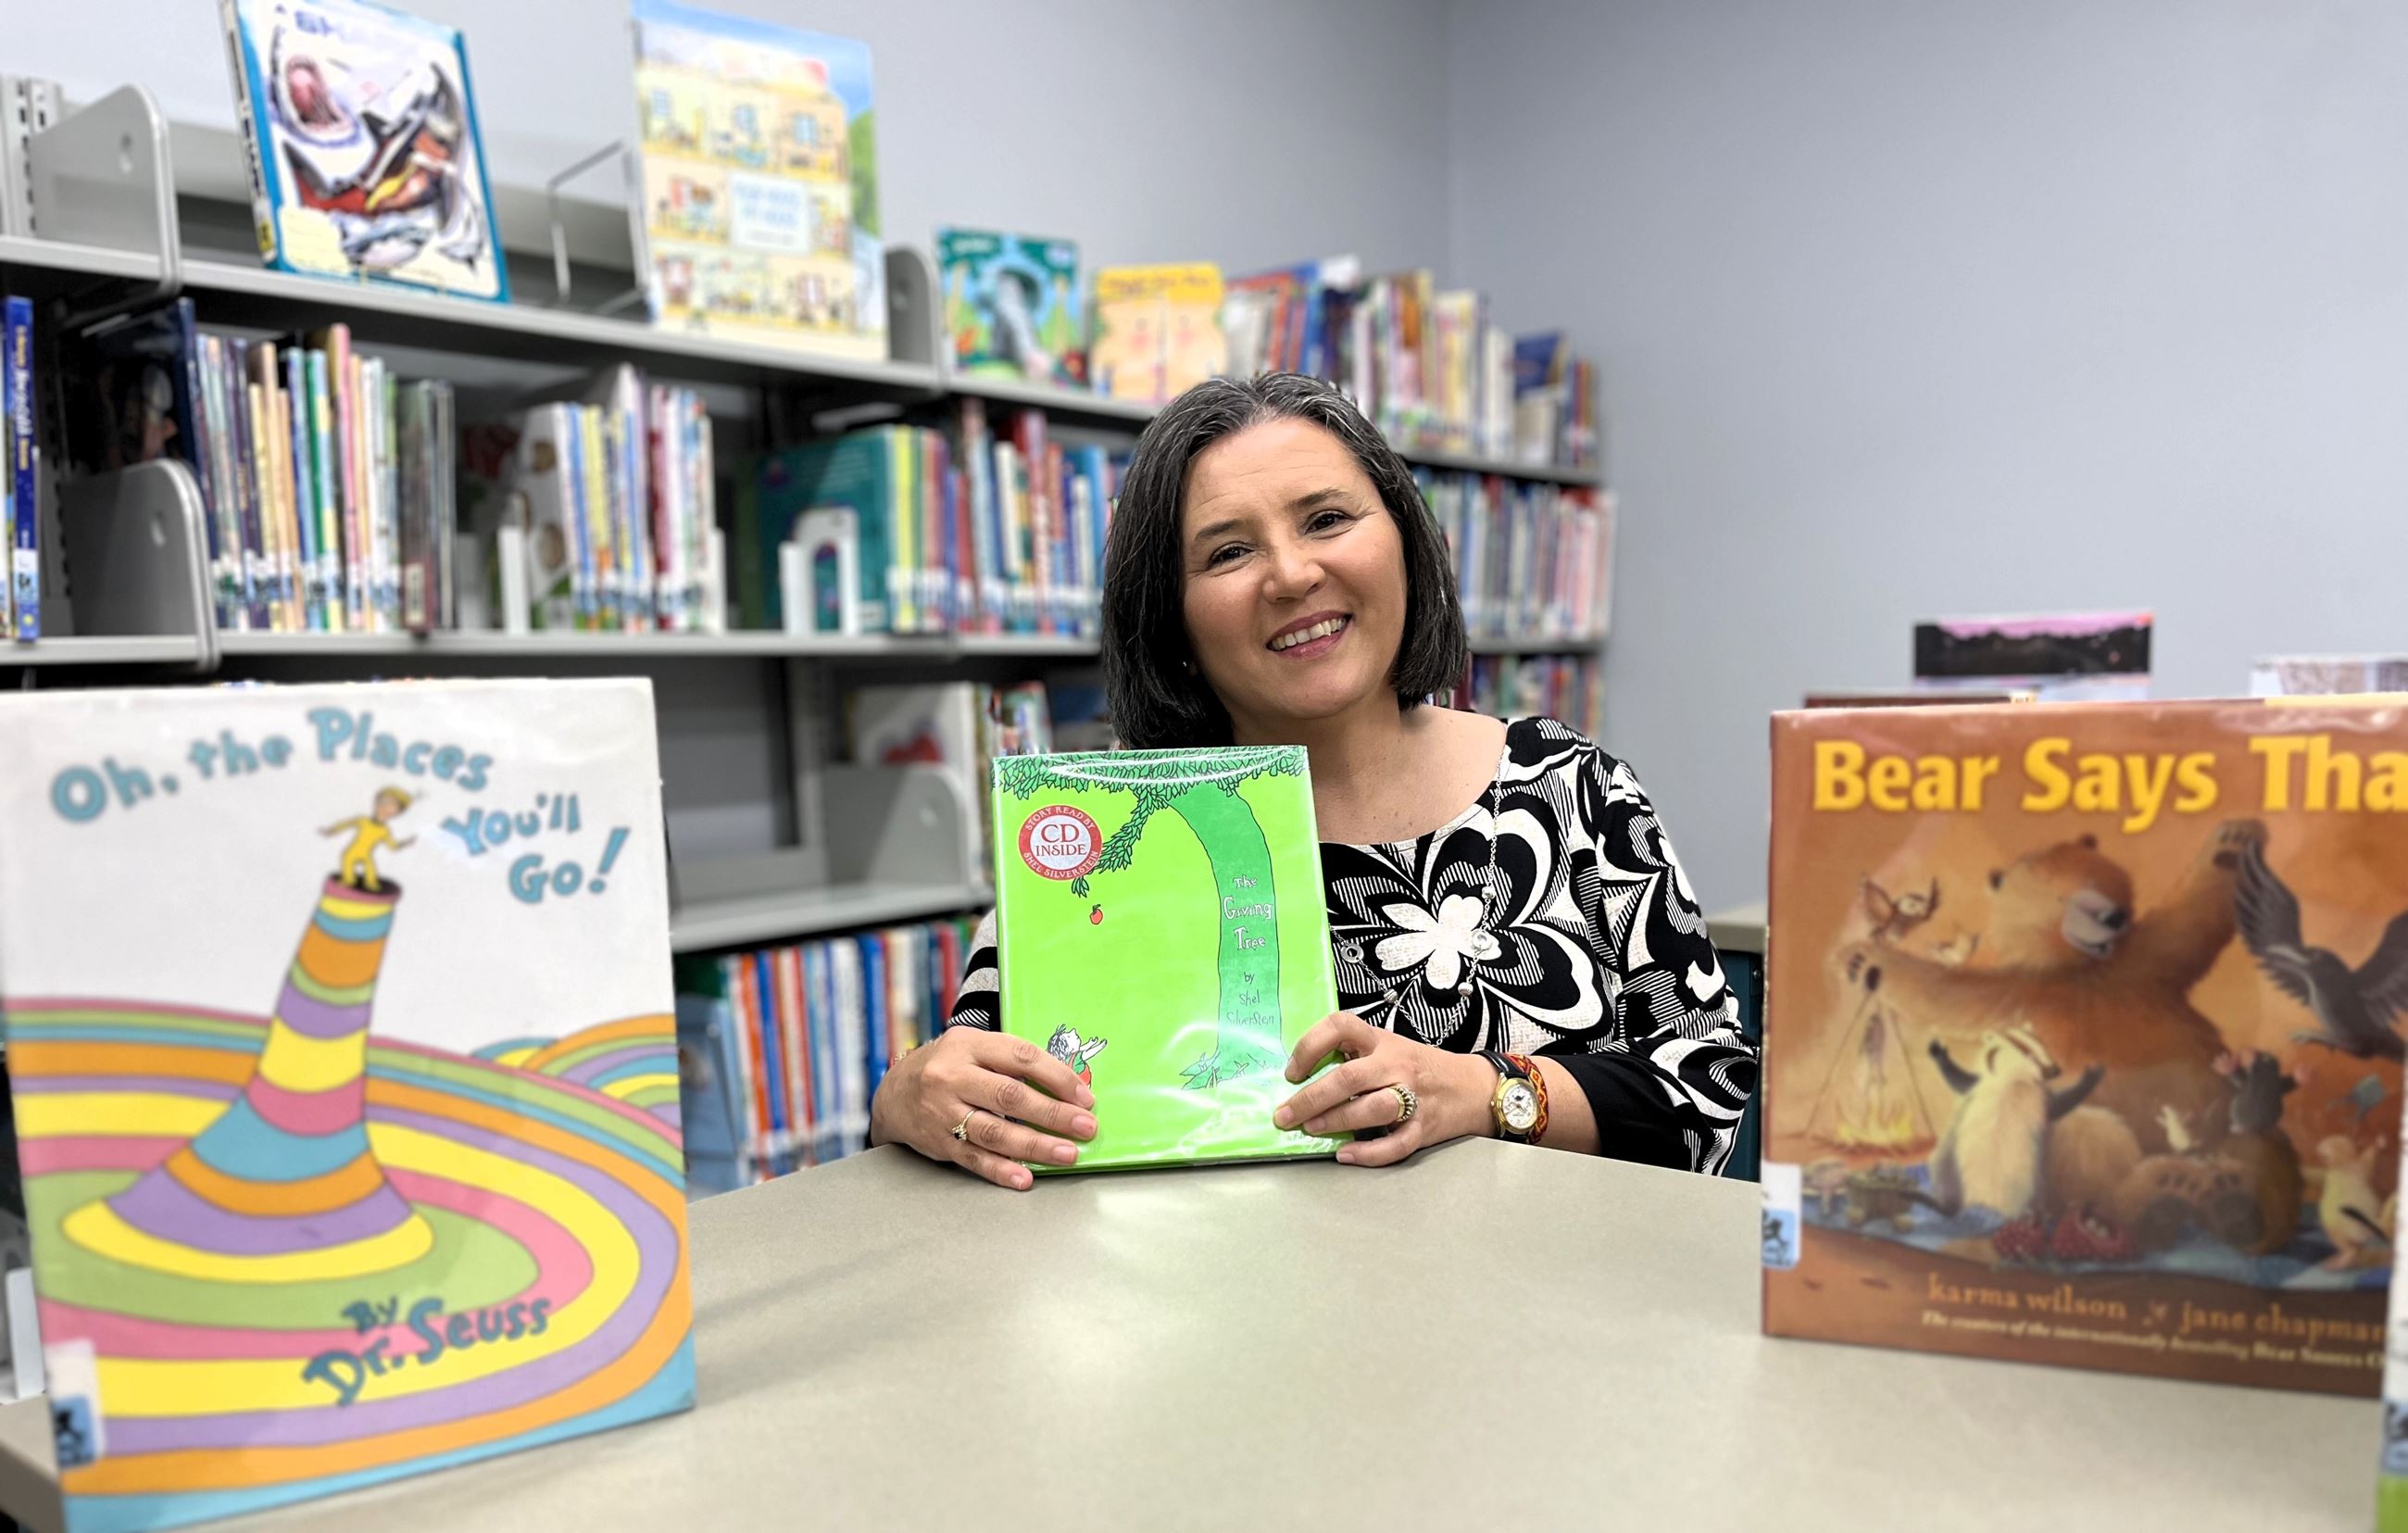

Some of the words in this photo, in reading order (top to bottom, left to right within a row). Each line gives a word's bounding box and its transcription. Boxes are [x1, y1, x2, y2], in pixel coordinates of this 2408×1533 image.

[50, 757, 180, 823] Oh,
[187, 729, 295, 779] the
[307, 705, 495, 792] Places
[1812, 740, 2000, 812] Bear
[2021, 736, 2219, 833] Says
[2249, 735, 2408, 812] Tha
[439, 793, 583, 857] You'll
[1024, 807, 1052, 831] STORY
[1056, 806, 1085, 820] READ
[1083, 817, 1096, 829] BY
[1040, 823, 1080, 843] CD
[507, 825, 632, 904] Go!
[1023, 851, 1043, 873] SHEL
[1044, 850, 1098, 878] SILVERSTEIN
[1035, 844, 1087, 857] INSIDE
[1233, 874, 1258, 889] The
[1223, 895, 1273, 921] Giving
[1234, 925, 1267, 950] Tree
[1243, 972, 1255, 985] by
[1927, 1272, 2020, 1309] karma
[2025, 1282, 2127, 1320] wilson
[2179, 1301, 2247, 1335] jane
[301, 1336, 406, 1408] Dr.
[408, 1297, 551, 1365] Seuss
